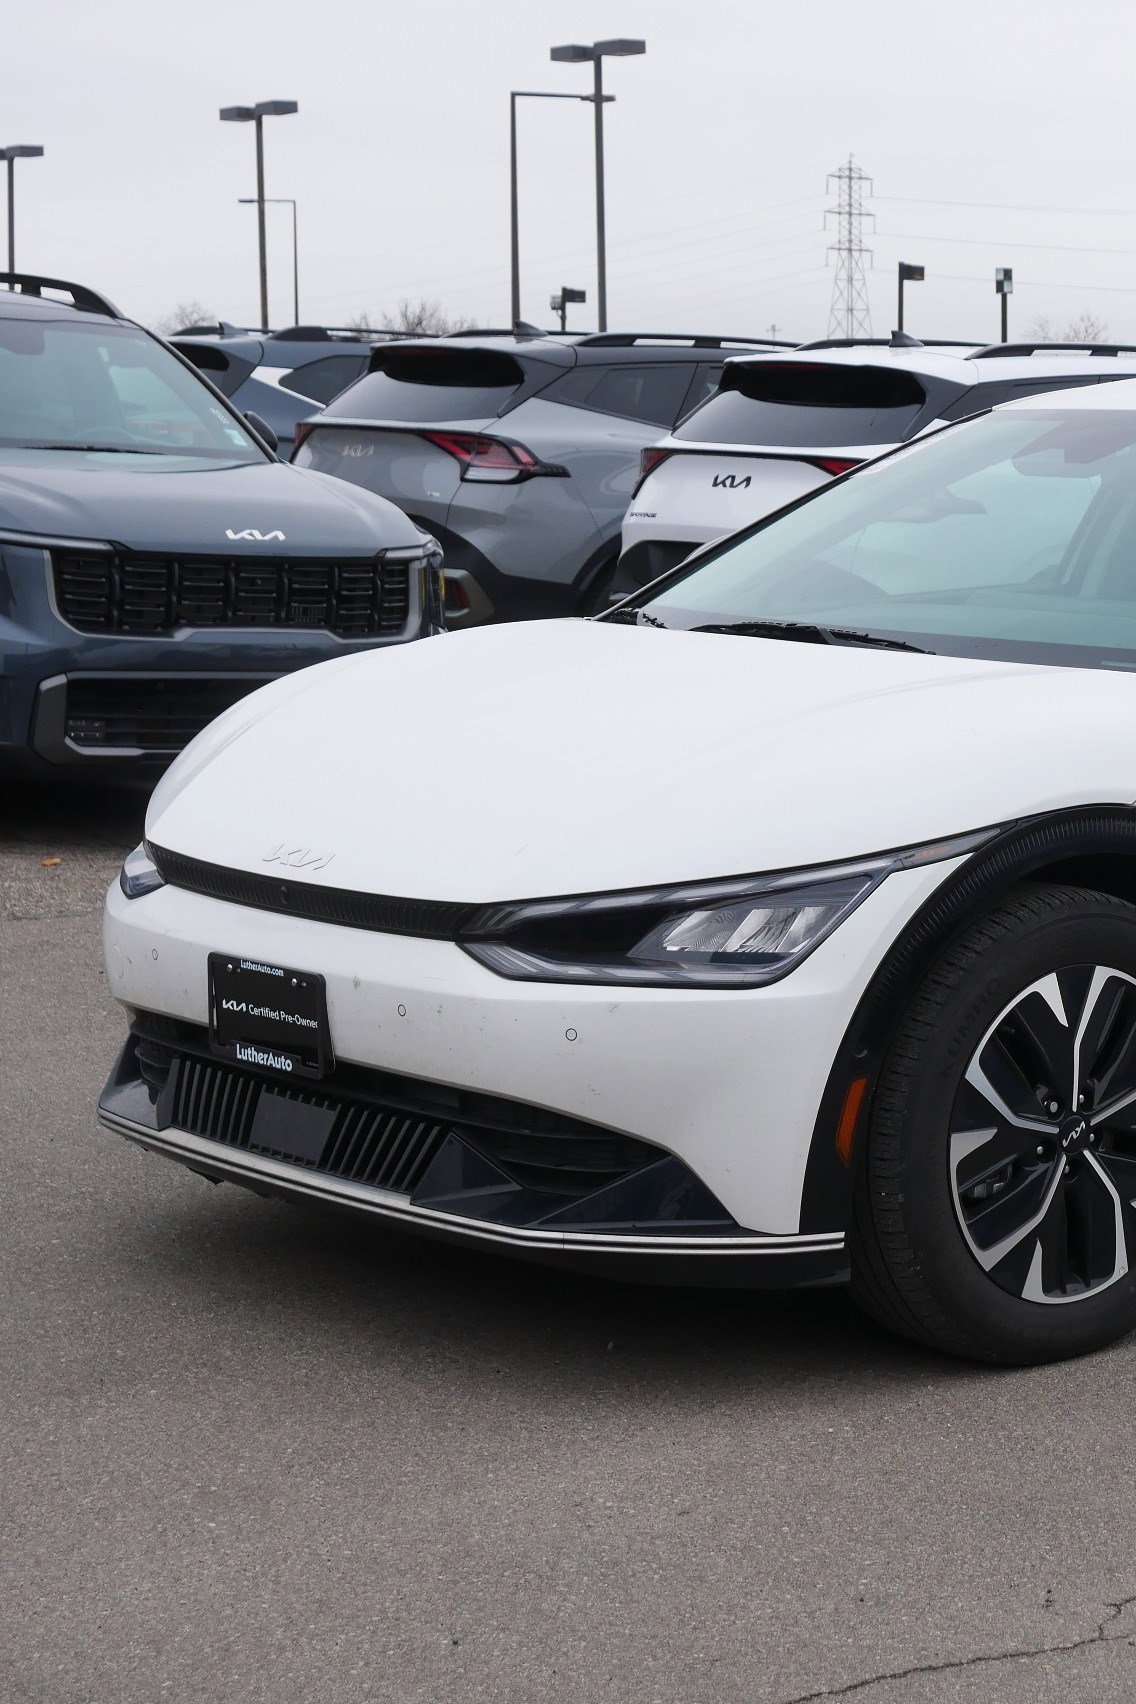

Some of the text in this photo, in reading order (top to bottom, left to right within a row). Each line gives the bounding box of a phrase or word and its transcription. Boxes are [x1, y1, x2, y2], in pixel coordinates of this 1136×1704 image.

[711, 474, 752, 489] KIA
[225, 528, 285, 541] KIA
[262, 840, 335, 871] KIA
[240, 959, 284, 977] LutherAuto.com
[222, 998, 246, 1012] KIA
[248, 1003, 280, 1020] Certified
[236, 1043, 293, 1072] LutherAuto
